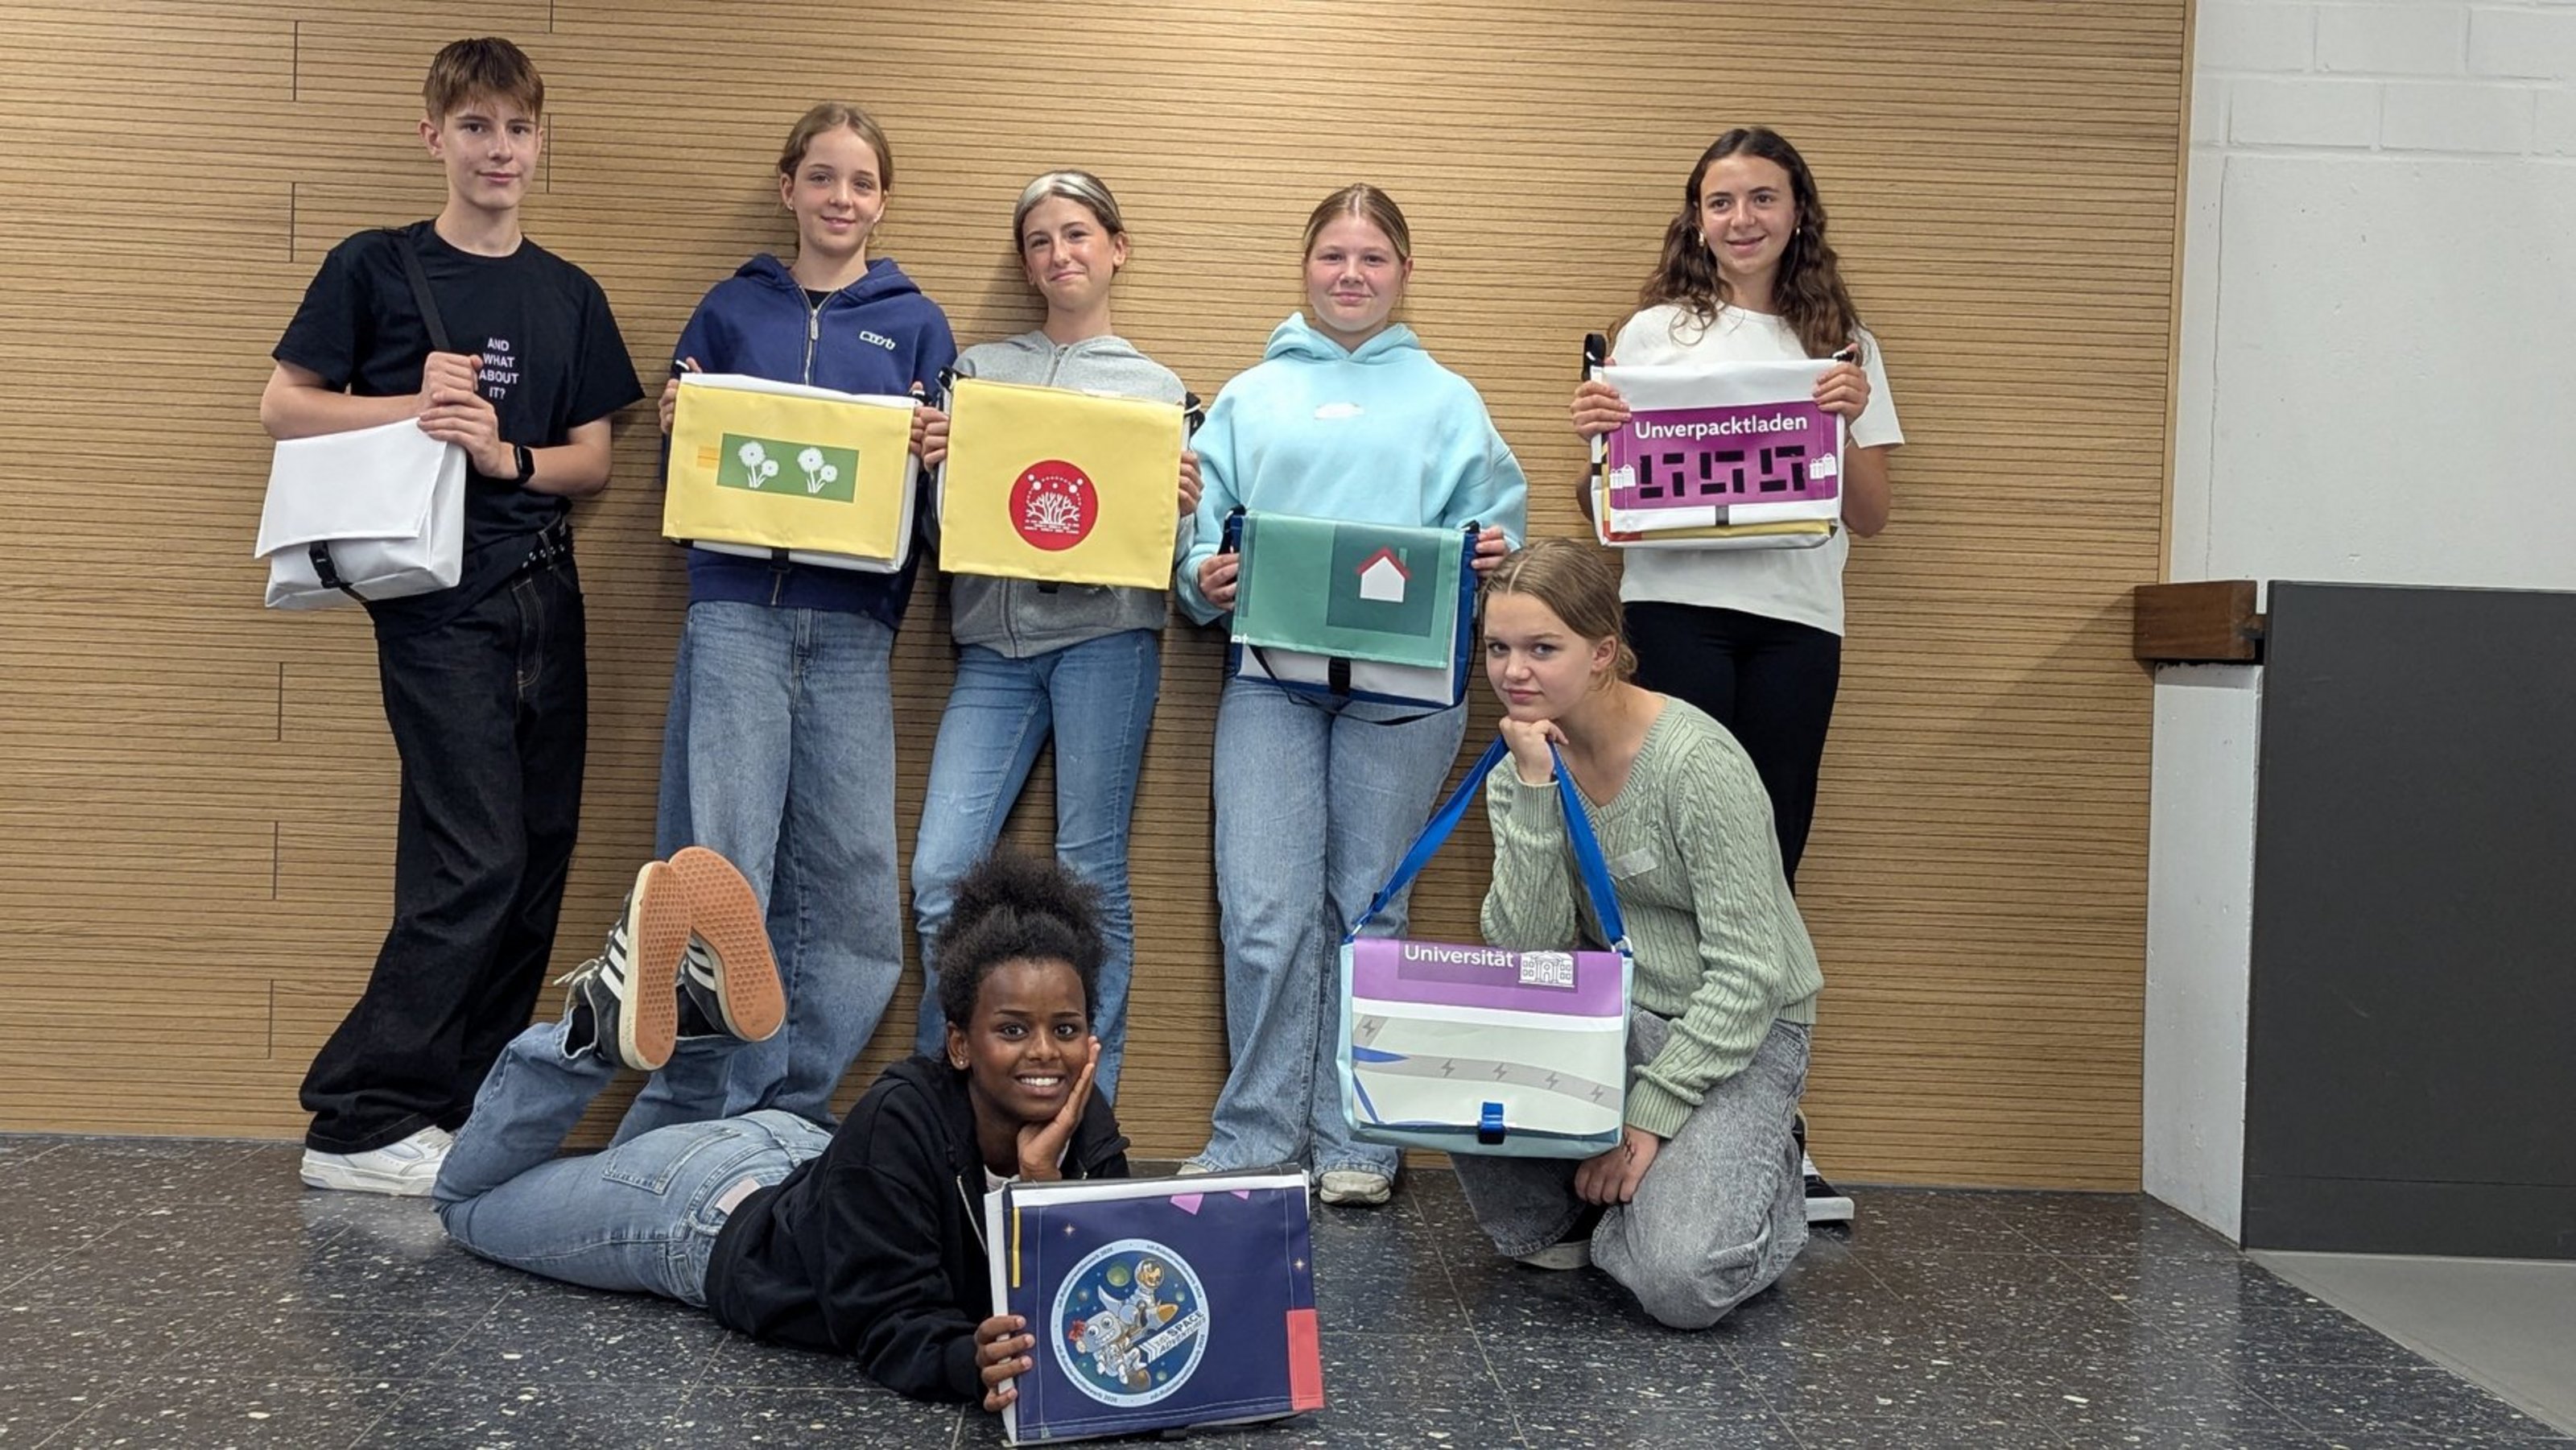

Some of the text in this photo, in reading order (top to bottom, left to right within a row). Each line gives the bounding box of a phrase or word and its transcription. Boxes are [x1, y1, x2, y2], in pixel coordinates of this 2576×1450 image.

[487, 337, 510, 352] AND
[483, 353, 515, 368] WHAT
[478, 369, 520, 384] ABOUT
[489, 386, 506, 399] IT?
[1635, 412, 1808, 440] Unverpacktladen
[1405, 944, 1514, 968] Universität
[1166, 1310, 1204, 1336] SPACE
